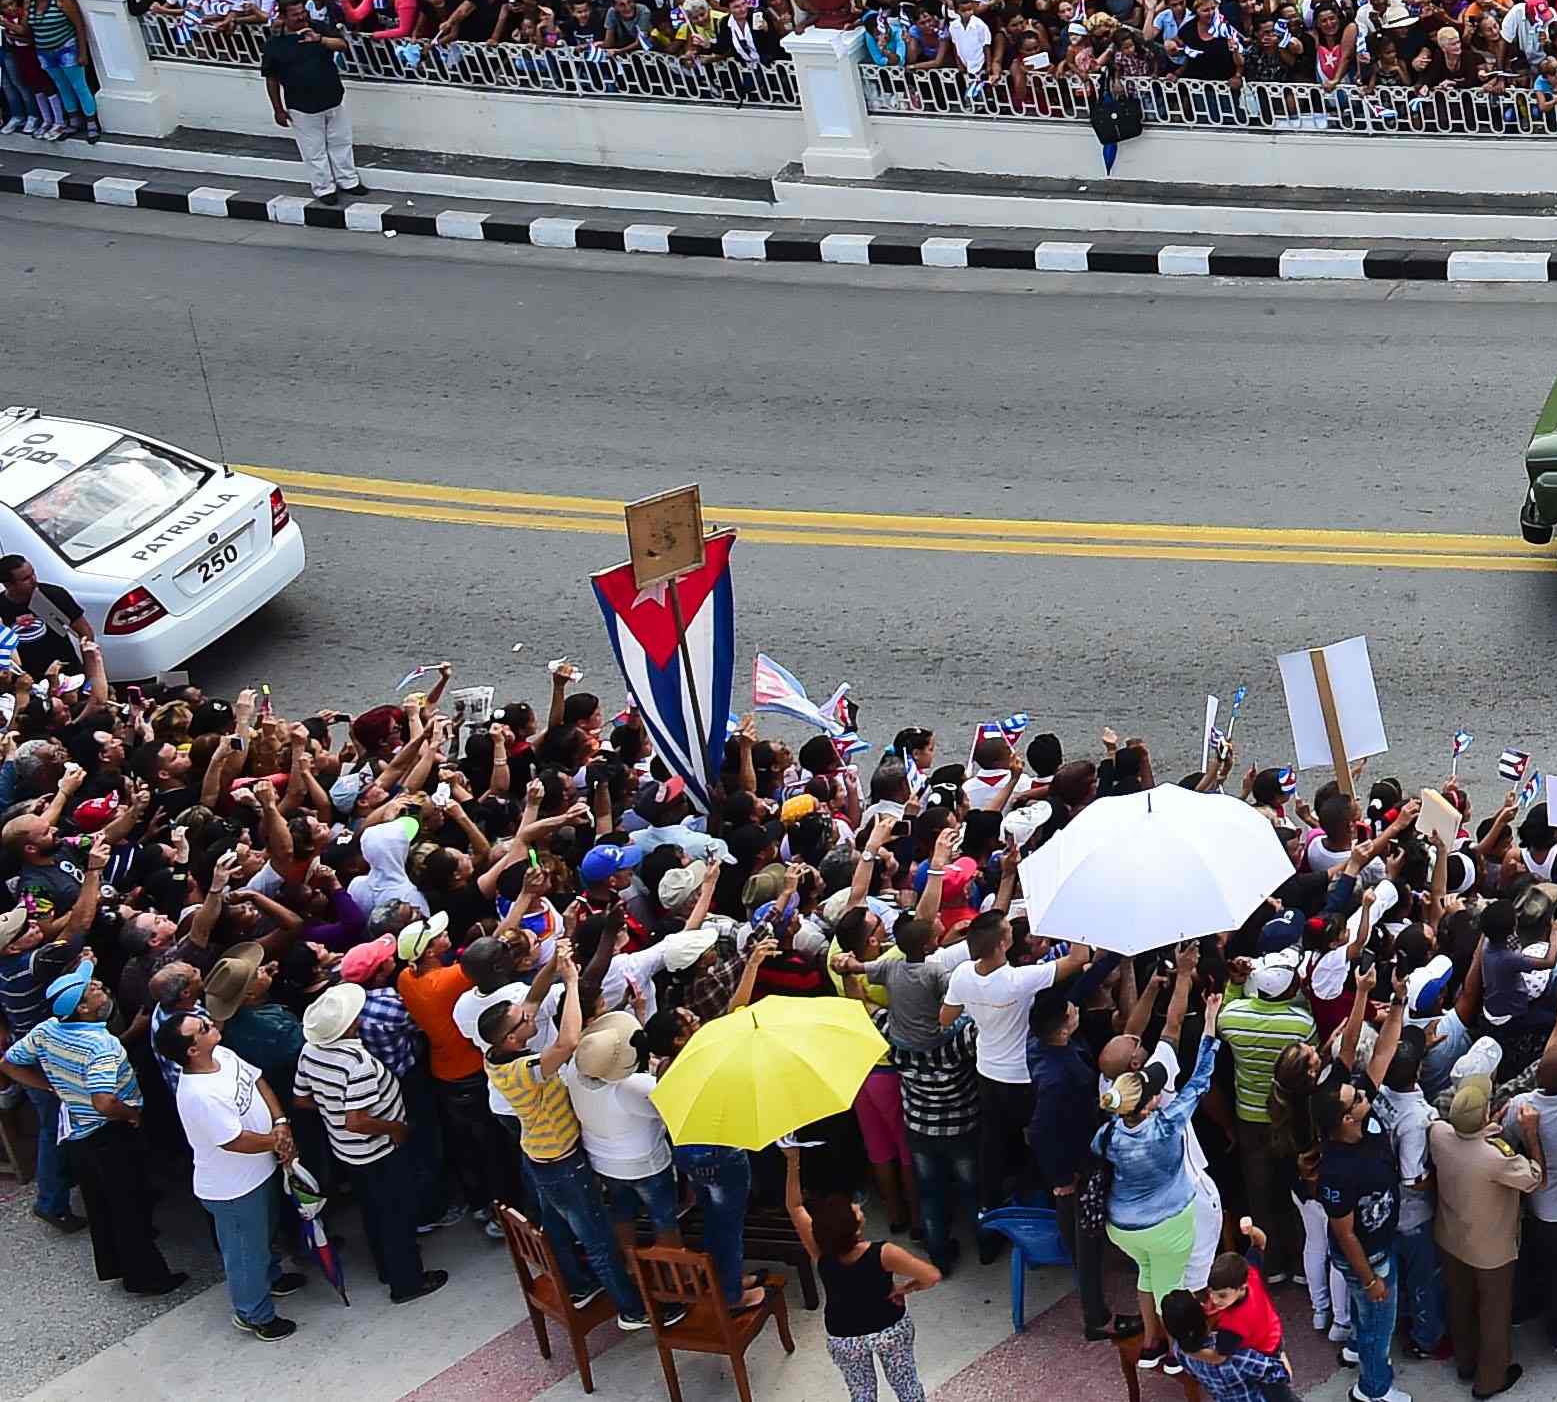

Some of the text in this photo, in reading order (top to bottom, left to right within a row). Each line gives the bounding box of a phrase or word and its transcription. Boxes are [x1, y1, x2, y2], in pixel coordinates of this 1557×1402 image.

[24, 450, 59, 465] B
[130, 493, 240, 561] PATRULLA
[197, 544, 238, 584] 250
